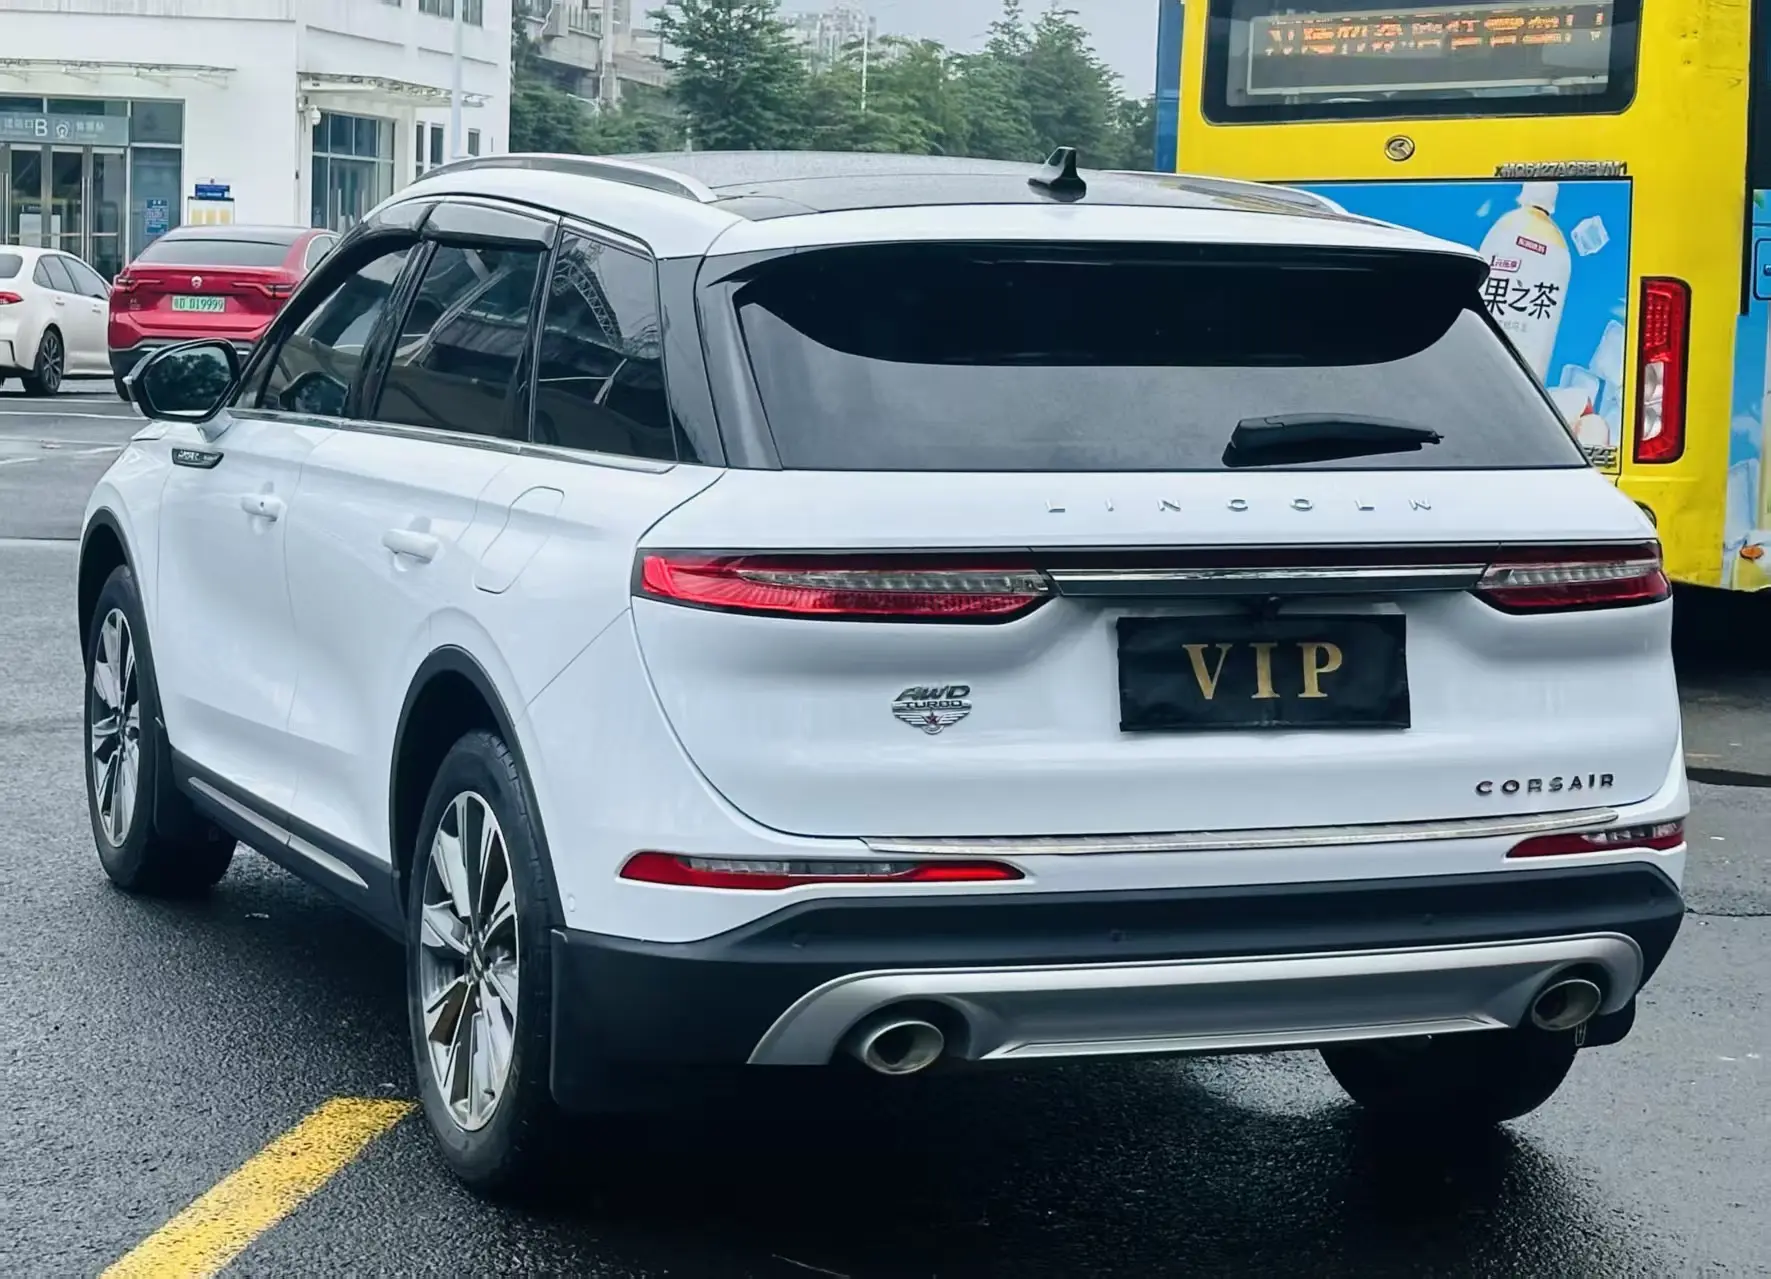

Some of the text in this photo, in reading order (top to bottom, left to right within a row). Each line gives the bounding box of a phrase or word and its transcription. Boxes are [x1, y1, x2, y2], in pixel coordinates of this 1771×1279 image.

[34, 118, 48, 137] B
[1483, 277, 1560, 319] 果之茶
[1045, 497, 1433, 513] LINCOLN
[1182, 642, 1343, 700] VIP
[895, 684, 971, 702] AWD
[904, 699, 963, 709] TURBO
[1475, 773, 1615, 796] CORSAIR
